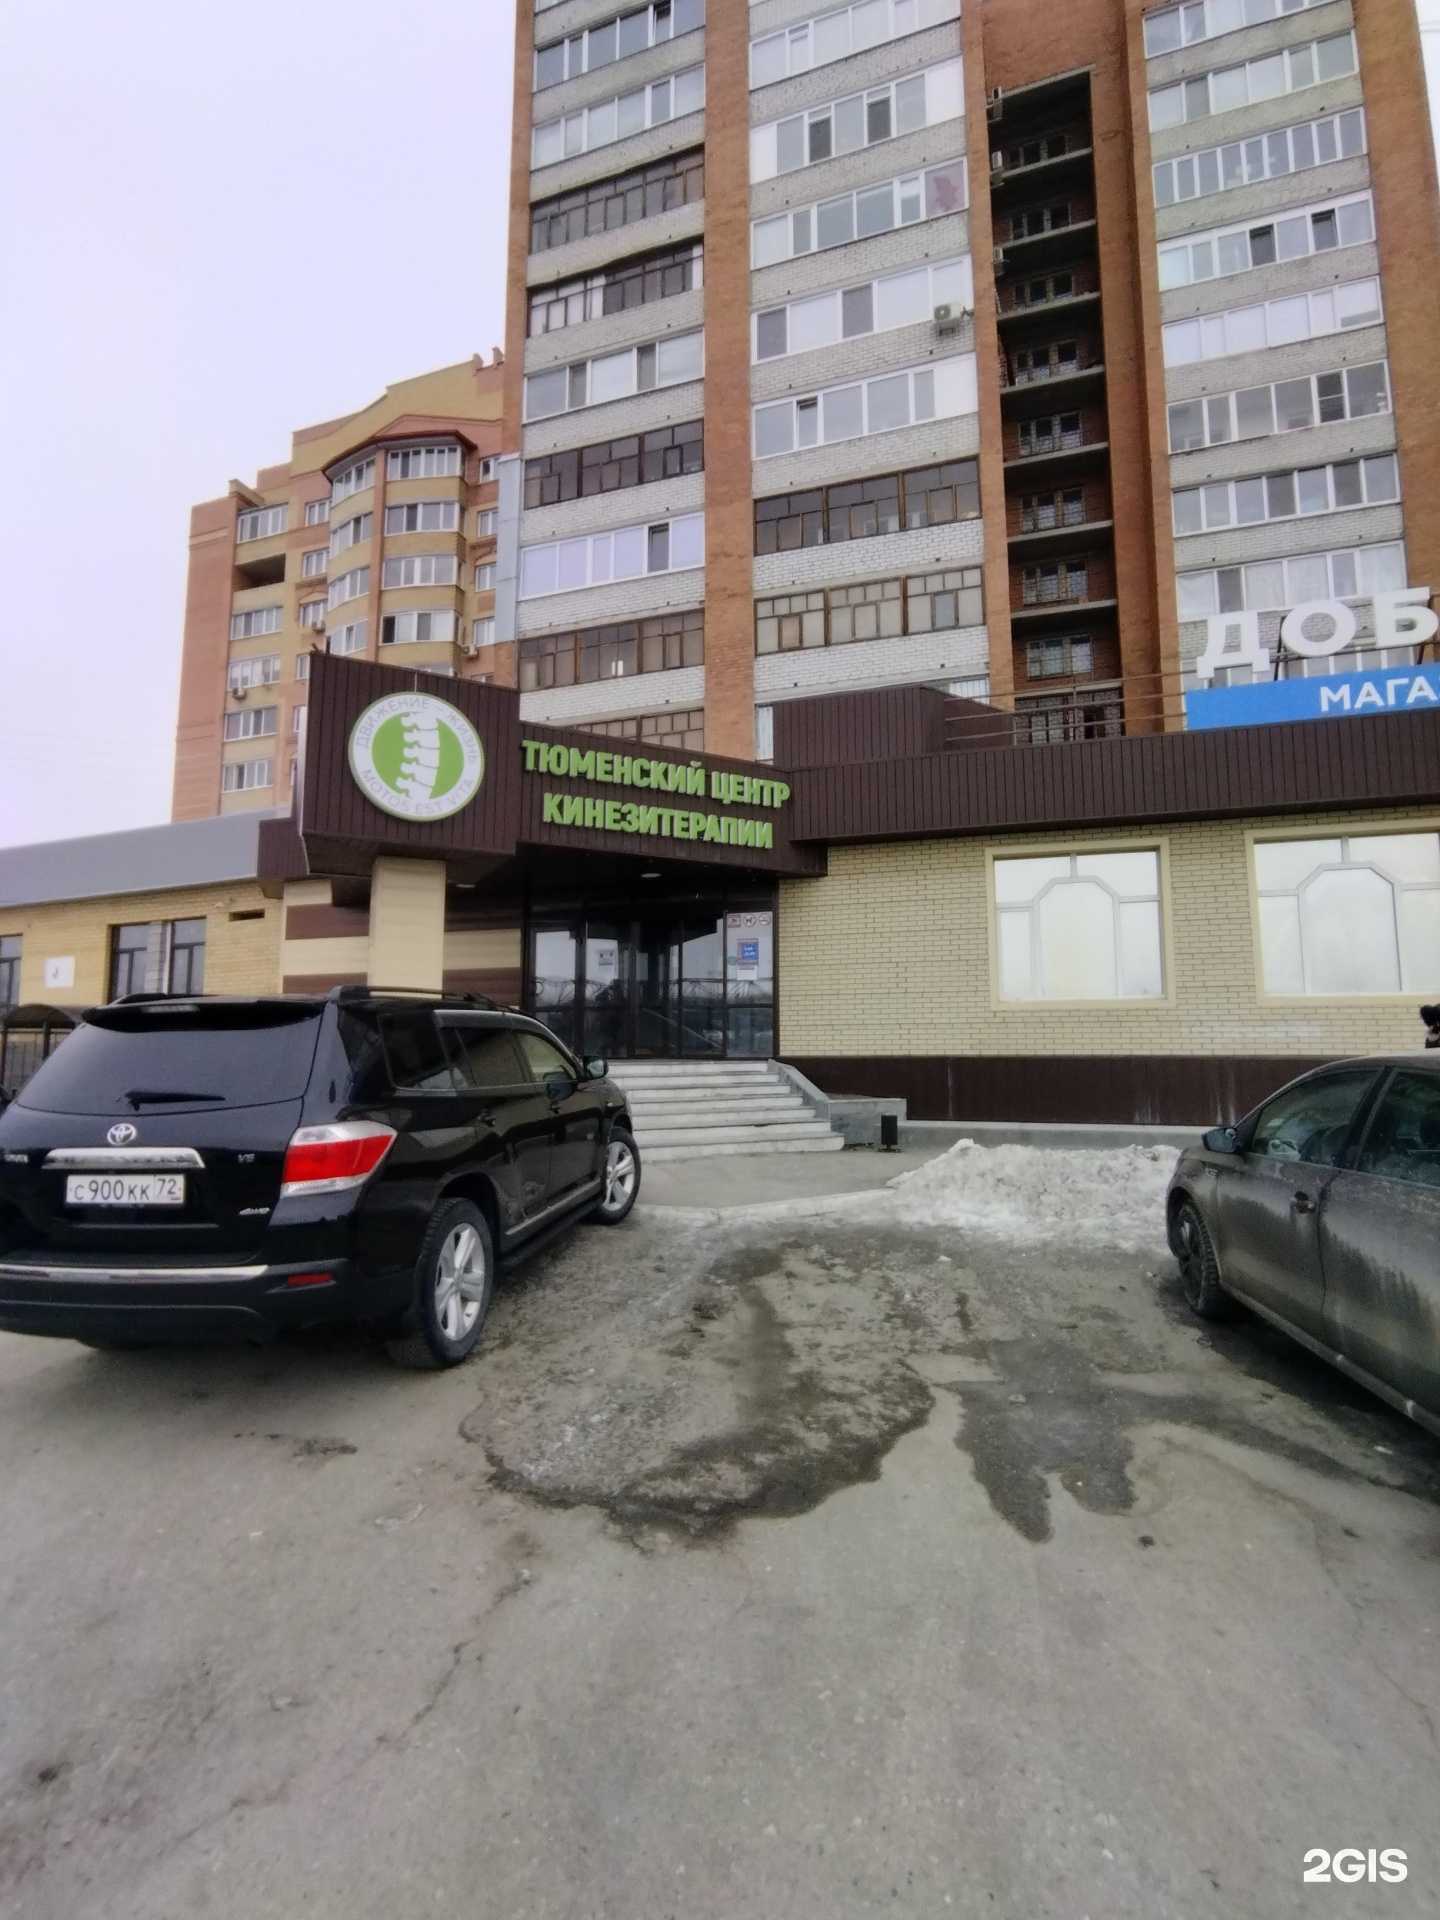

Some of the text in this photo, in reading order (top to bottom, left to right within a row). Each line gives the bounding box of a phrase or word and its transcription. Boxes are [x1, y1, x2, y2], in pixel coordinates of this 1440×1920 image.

[1196, 586, 1439, 678] ДОБ
[1320, 676, 1438, 712] МАГА
[356, 697, 479, 763] ДВИЖЕНИЕ ЖИЗНЬ
[521, 739, 792, 809] ТЮМЕНСКИЙ ЦЕНТР
[543, 792, 774, 849] КИНЕЗИТЕРАПИИ
